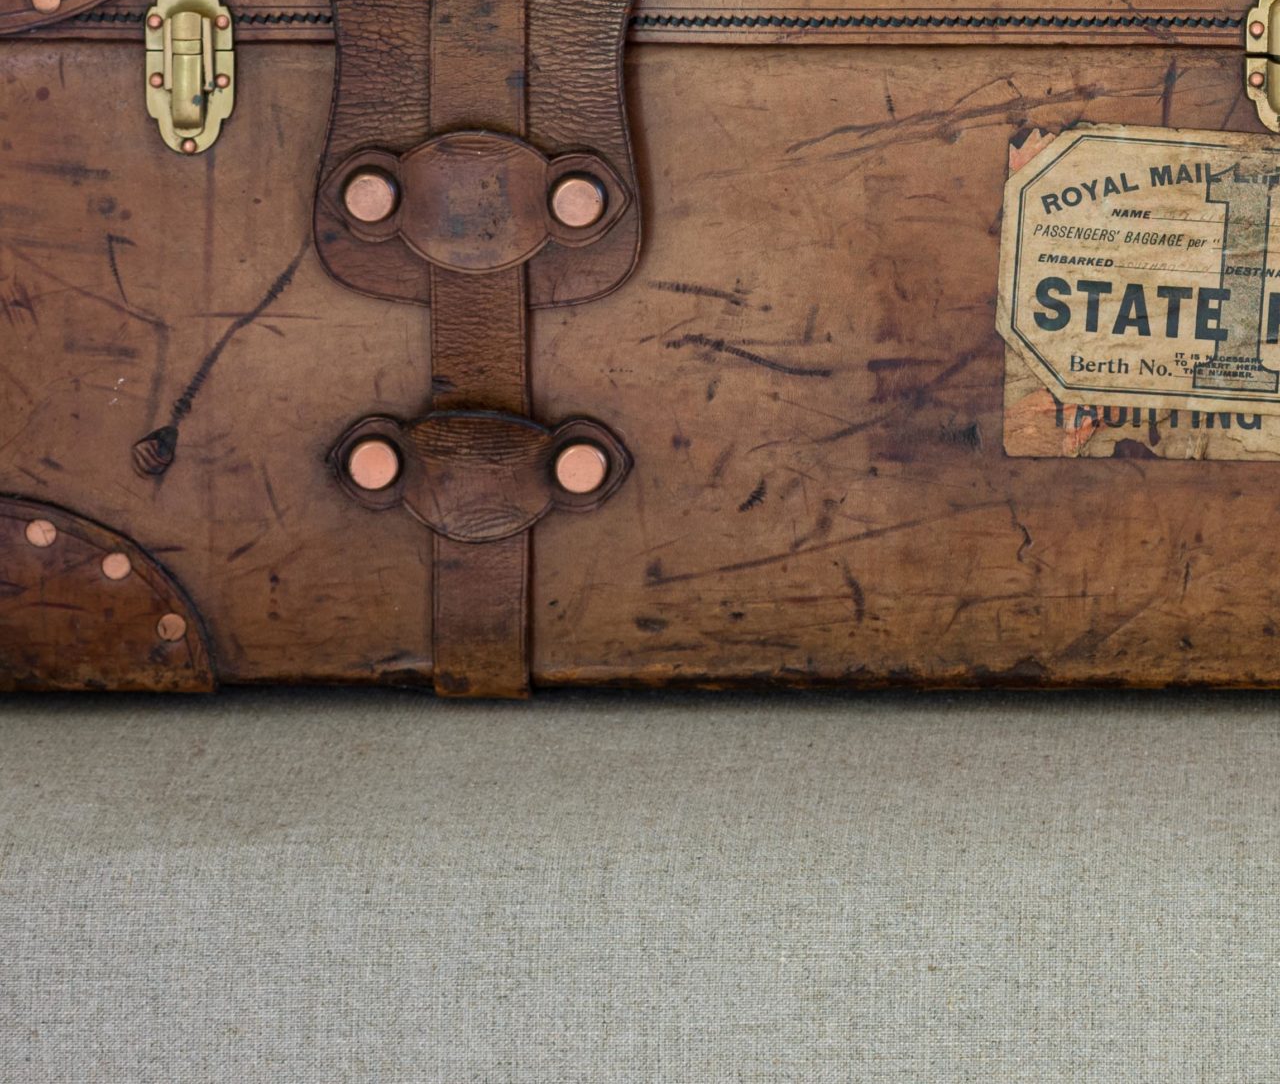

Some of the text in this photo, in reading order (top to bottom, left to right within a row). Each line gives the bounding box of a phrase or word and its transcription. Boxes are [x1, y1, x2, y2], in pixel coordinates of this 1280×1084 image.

[1040, 173, 1140, 215] ROYAL
[1149, 162, 1222, 187] MAIL
[1111, 208, 1152, 220] NAME
[1124, 231, 1185, 247] BAGGAGE
[1187, 237, 1208, 250] per
[1037, 253, 1114, 268] EMBARKED
[1033, 276, 1231, 341] STATE
[1070, 355, 1173, 378] Berth No.
[1174, 359, 1188, 367] TO
[1183, 367, 1255, 379] THE NUMBER.
